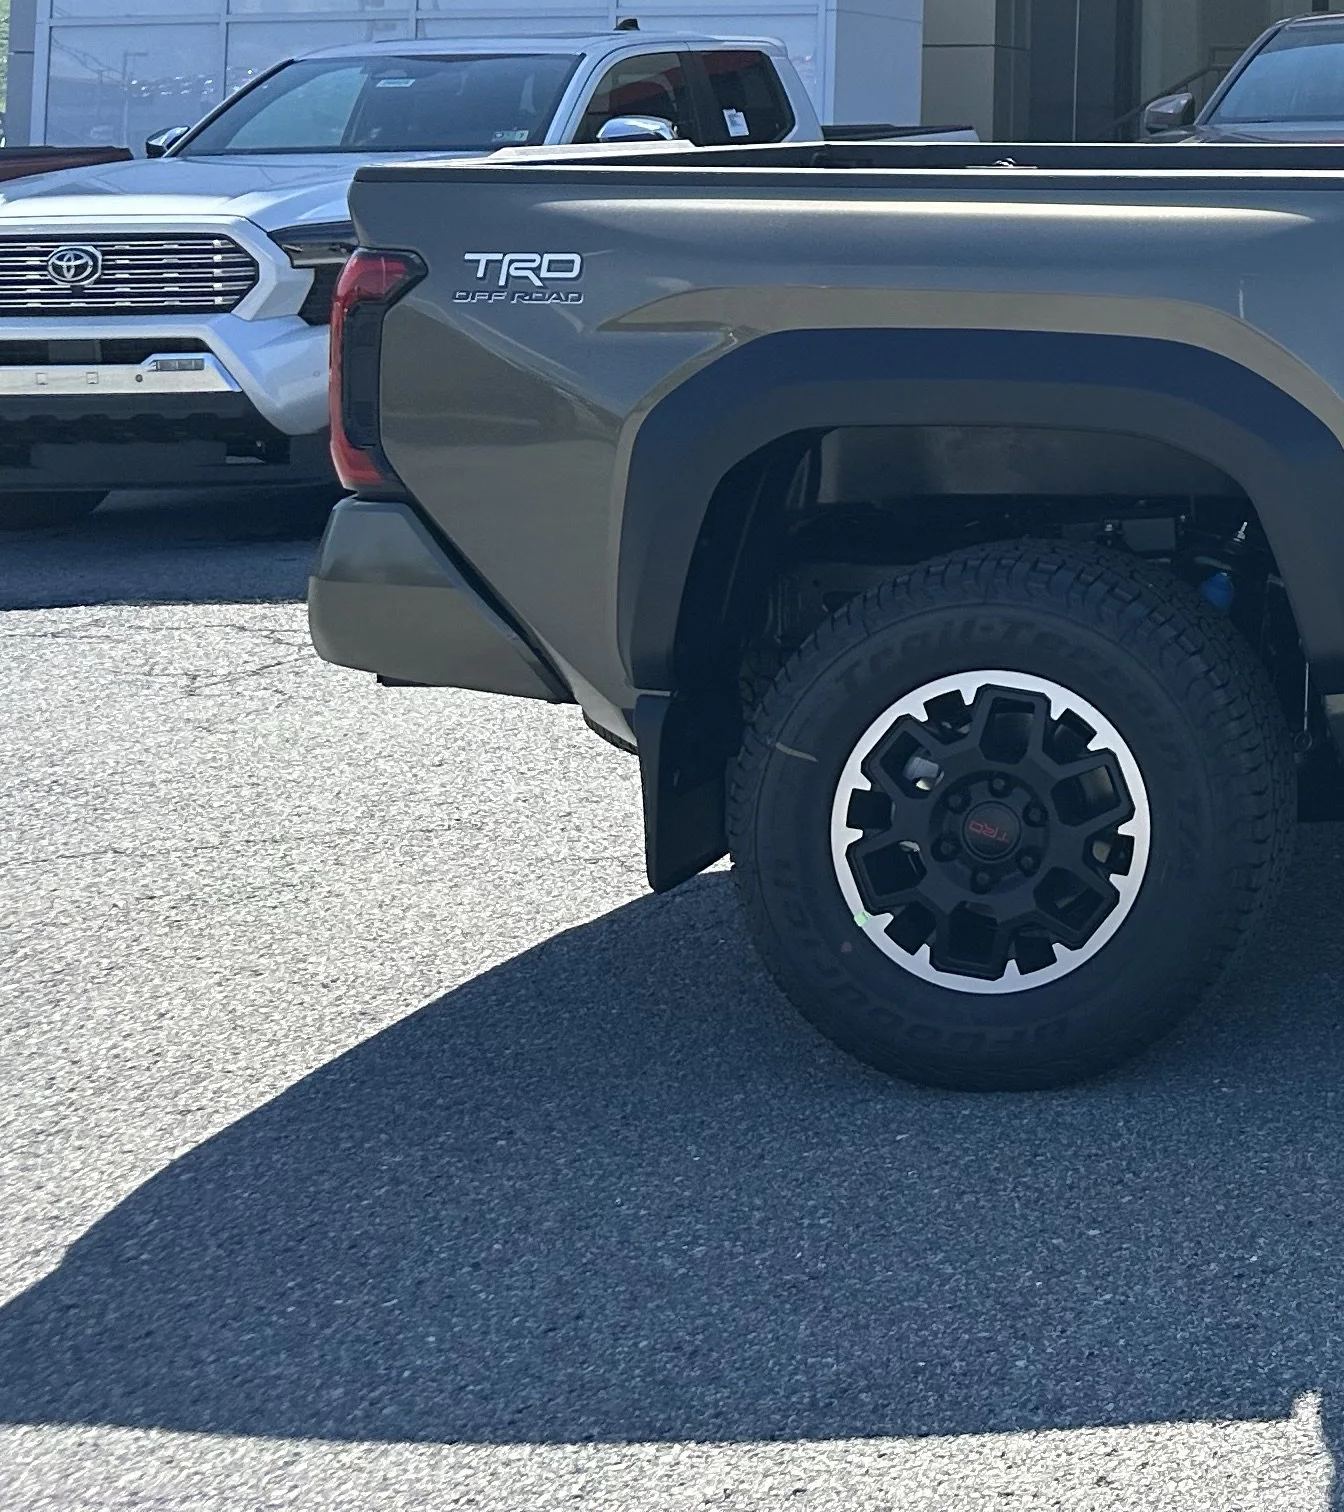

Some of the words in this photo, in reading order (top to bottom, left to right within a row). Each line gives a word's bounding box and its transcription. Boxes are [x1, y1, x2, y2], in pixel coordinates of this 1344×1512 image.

[464, 252, 583, 287] TRD
[453, 291, 507, 303] OFF
[511, 291, 584, 304] ROAD
[968, 818, 1010, 844] TRD
